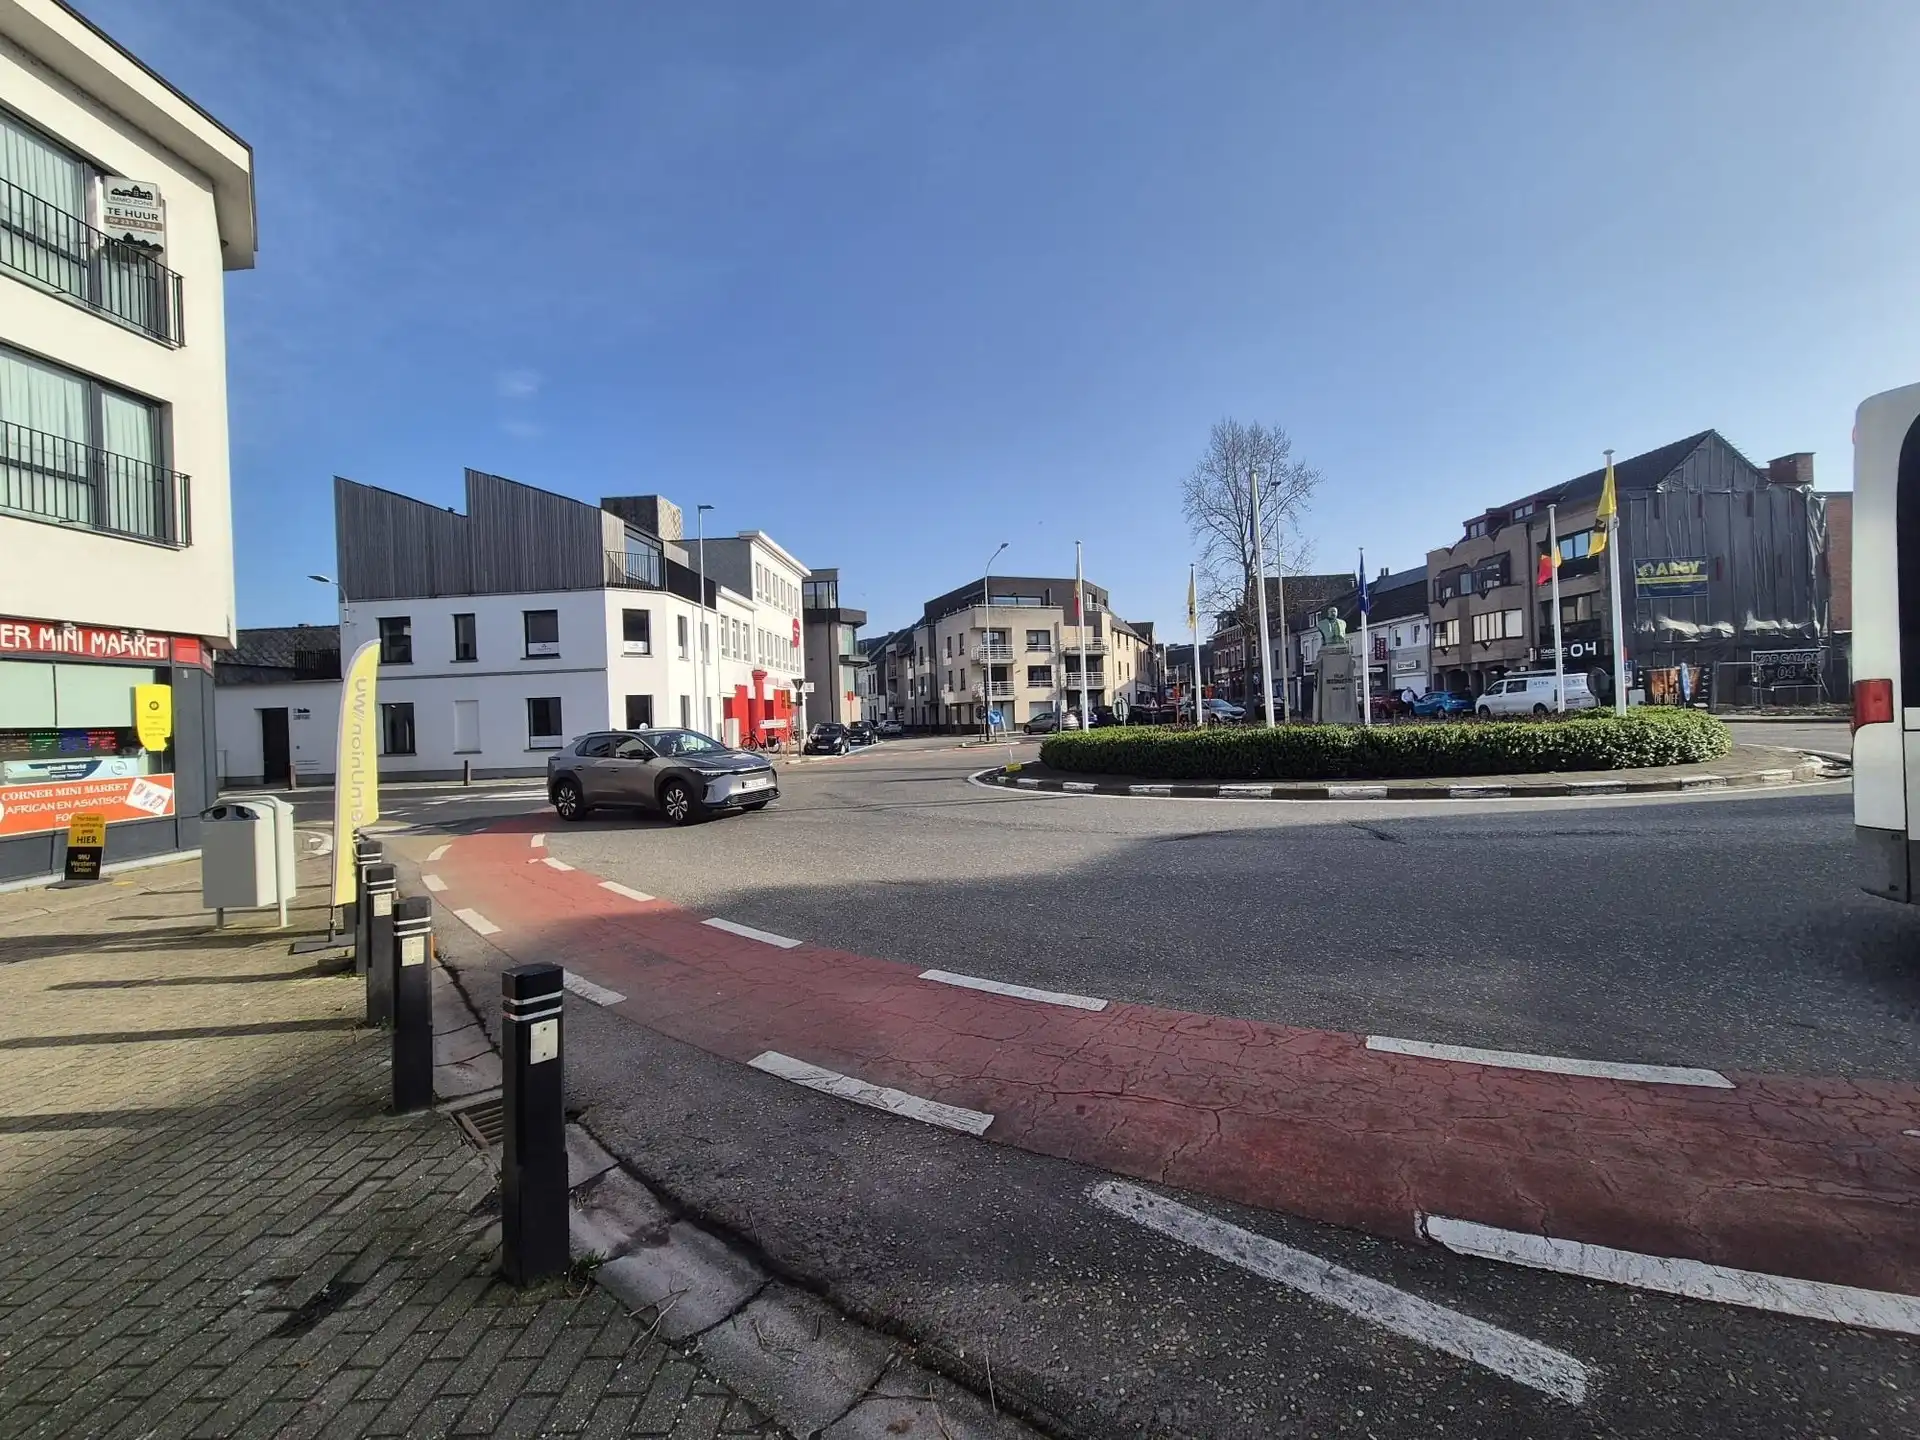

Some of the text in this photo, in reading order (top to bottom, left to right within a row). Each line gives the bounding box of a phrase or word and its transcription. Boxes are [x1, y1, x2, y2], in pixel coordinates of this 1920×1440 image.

[107, 207, 159, 221] TE HUUR
[91, 632, 167, 658] MARKET
[1571, 641, 1597, 657] 04
[1777, 665, 1796, 680] 04
[2, 783, 129, 801] CORNER MINI MARKET
[5, 796, 126, 815] AFRICAN EN ASIATISCH
[76, 836, 97, 844] HIER
